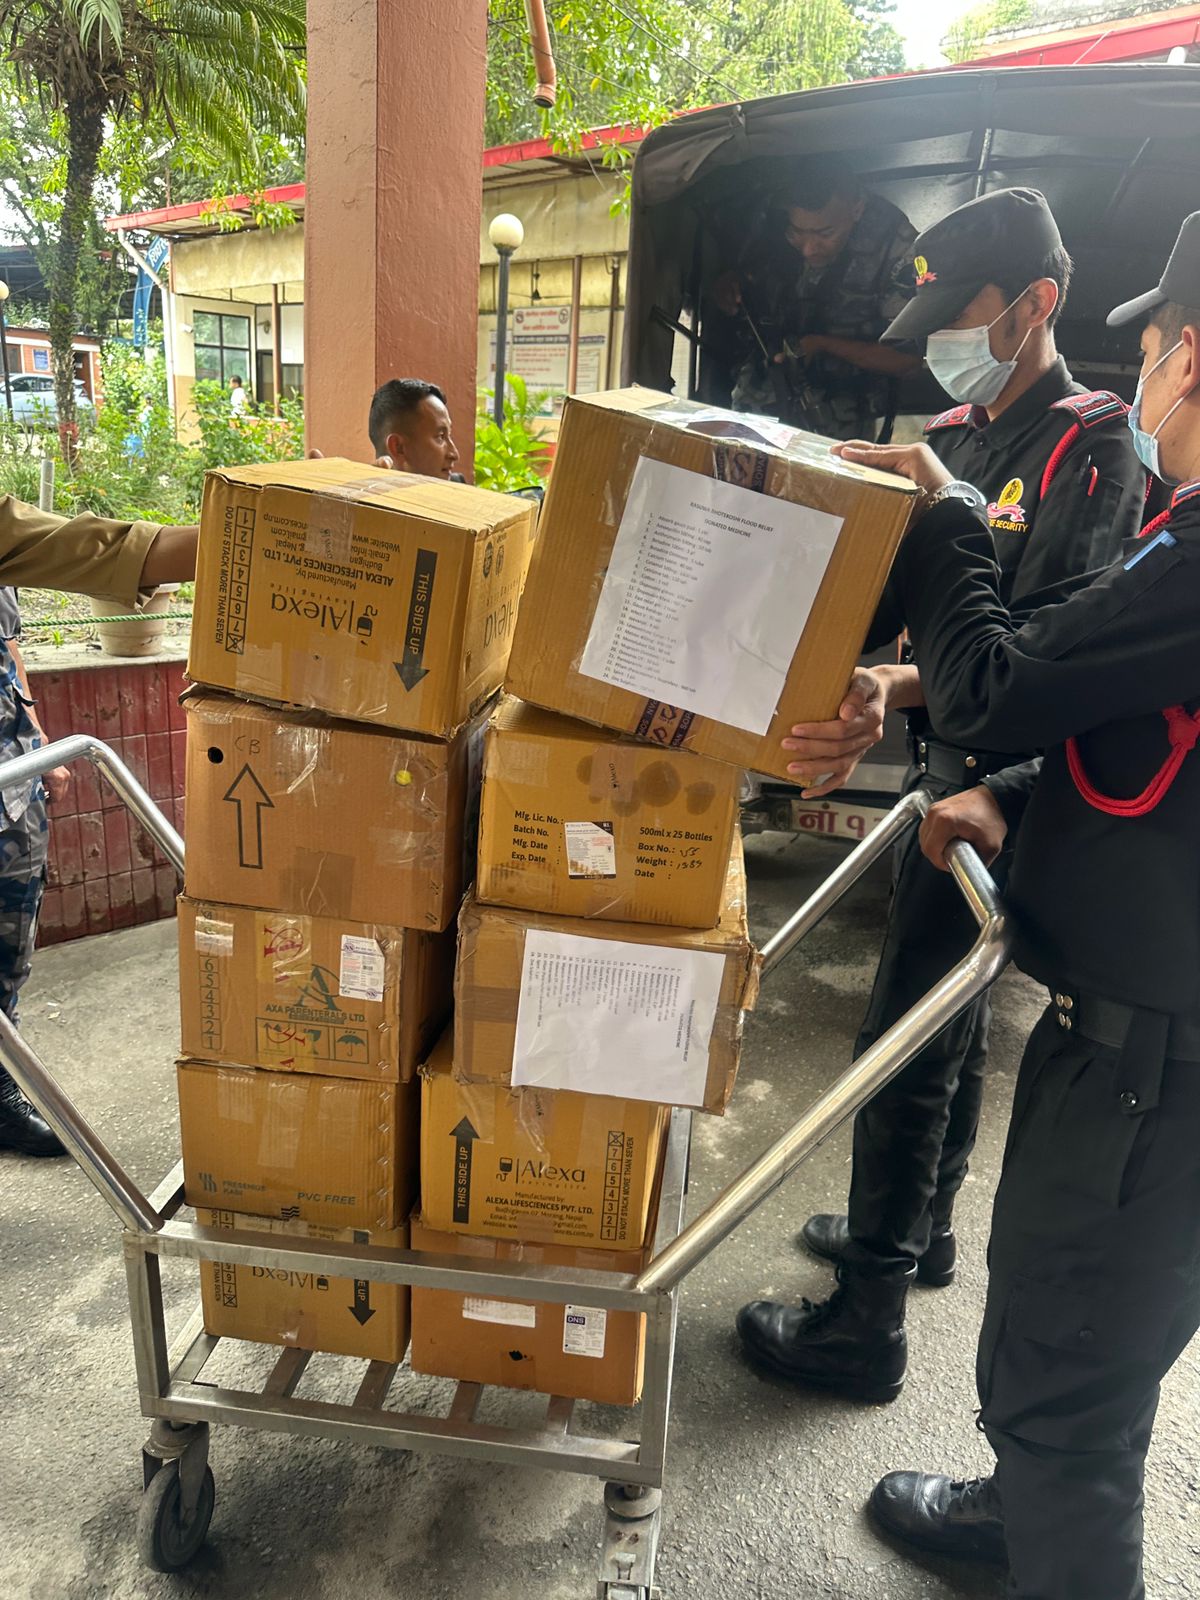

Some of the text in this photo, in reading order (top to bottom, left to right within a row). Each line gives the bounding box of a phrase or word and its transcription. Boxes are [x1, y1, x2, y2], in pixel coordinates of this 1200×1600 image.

[243, 511, 248, 524] 1
[727, 525, 751, 538] MEDICINE
[740, 518, 757, 527] FLOOD
[757, 523, 773, 532] RELIEF
[996, 520, 1029, 533] SECURITY
[239, 529, 247, 544] 2
[369, 537, 400, 552] Website:
[238, 548, 245, 561] 3
[275, 538, 382, 571] Budhigan Nepal
[367, 548, 390, 561] Email:
[237, 567, 244, 579] 4
[261, 547, 393, 586] ALEXA LIFESCIENCES PVT. LTD.
[215, 505, 233, 644] DO NOT STACK MORE THAN SEVEN
[307, 571, 356, 590] Manufactured
[236, 584, 242, 597] 5
[234, 602, 240, 614] 6
[270, 592, 346, 631] Alexa
[408, 571, 429, 655] THIS SIDE UP
[233, 620, 239, 632] 7
[515, 810, 560, 824] Mfg. Lic. No.
[514, 824, 549, 836] Batch No.
[847, 814, 865, 838] १
[640, 827, 665, 837] 500ml
[673, 830, 683, 839] 25
[684, 831, 713, 842] Bottles
[513, 838, 548, 850] Mfg. Date
[638, 842, 654, 852] Box
[512, 852, 546, 863] Exp. Date
[636, 855, 667, 867] Weight
[634, 869, 655, 878] Date
[205, 959, 214, 972] 6
[205, 974, 213, 988] 5
[205, 990, 213, 1003] 4
[206, 1005, 214, 1018] 3
[266, 1004, 283, 1013] AXA
[285, 1006, 347, 1019] PARENTERALS
[349, 1014, 367, 1022] LTD.
[205, 1020, 214, 1033] 2
[208, 1036, 213, 1050] 1
[612, 1148, 618, 1157] 7
[521, 1160, 585, 1182] Alexa
[611, 1163, 617, 1171] 6
[624, 1159, 632, 1175] THAN
[457, 1146, 468, 1208] THIS SIDE UP
[610, 1176, 616, 1185] 5
[297, 1192, 356, 1205] PVC FREE
[515, 1192, 555, 1202] Manufactured
[609, 1190, 615, 1198] 4
[486, 1196, 594, 1215] ALEXA LIFESCIENCES PVT. LTD.
[608, 1203, 614, 1211] 3
[621, 1197, 629, 1216] STACK
[607, 1216, 612, 1224] 2
[606, 1229, 611, 1237] 1
[619, 1231, 626, 1240] DO
[253, 1266, 308, 1288] Alexa
[358, 1289, 366, 1301] UP
